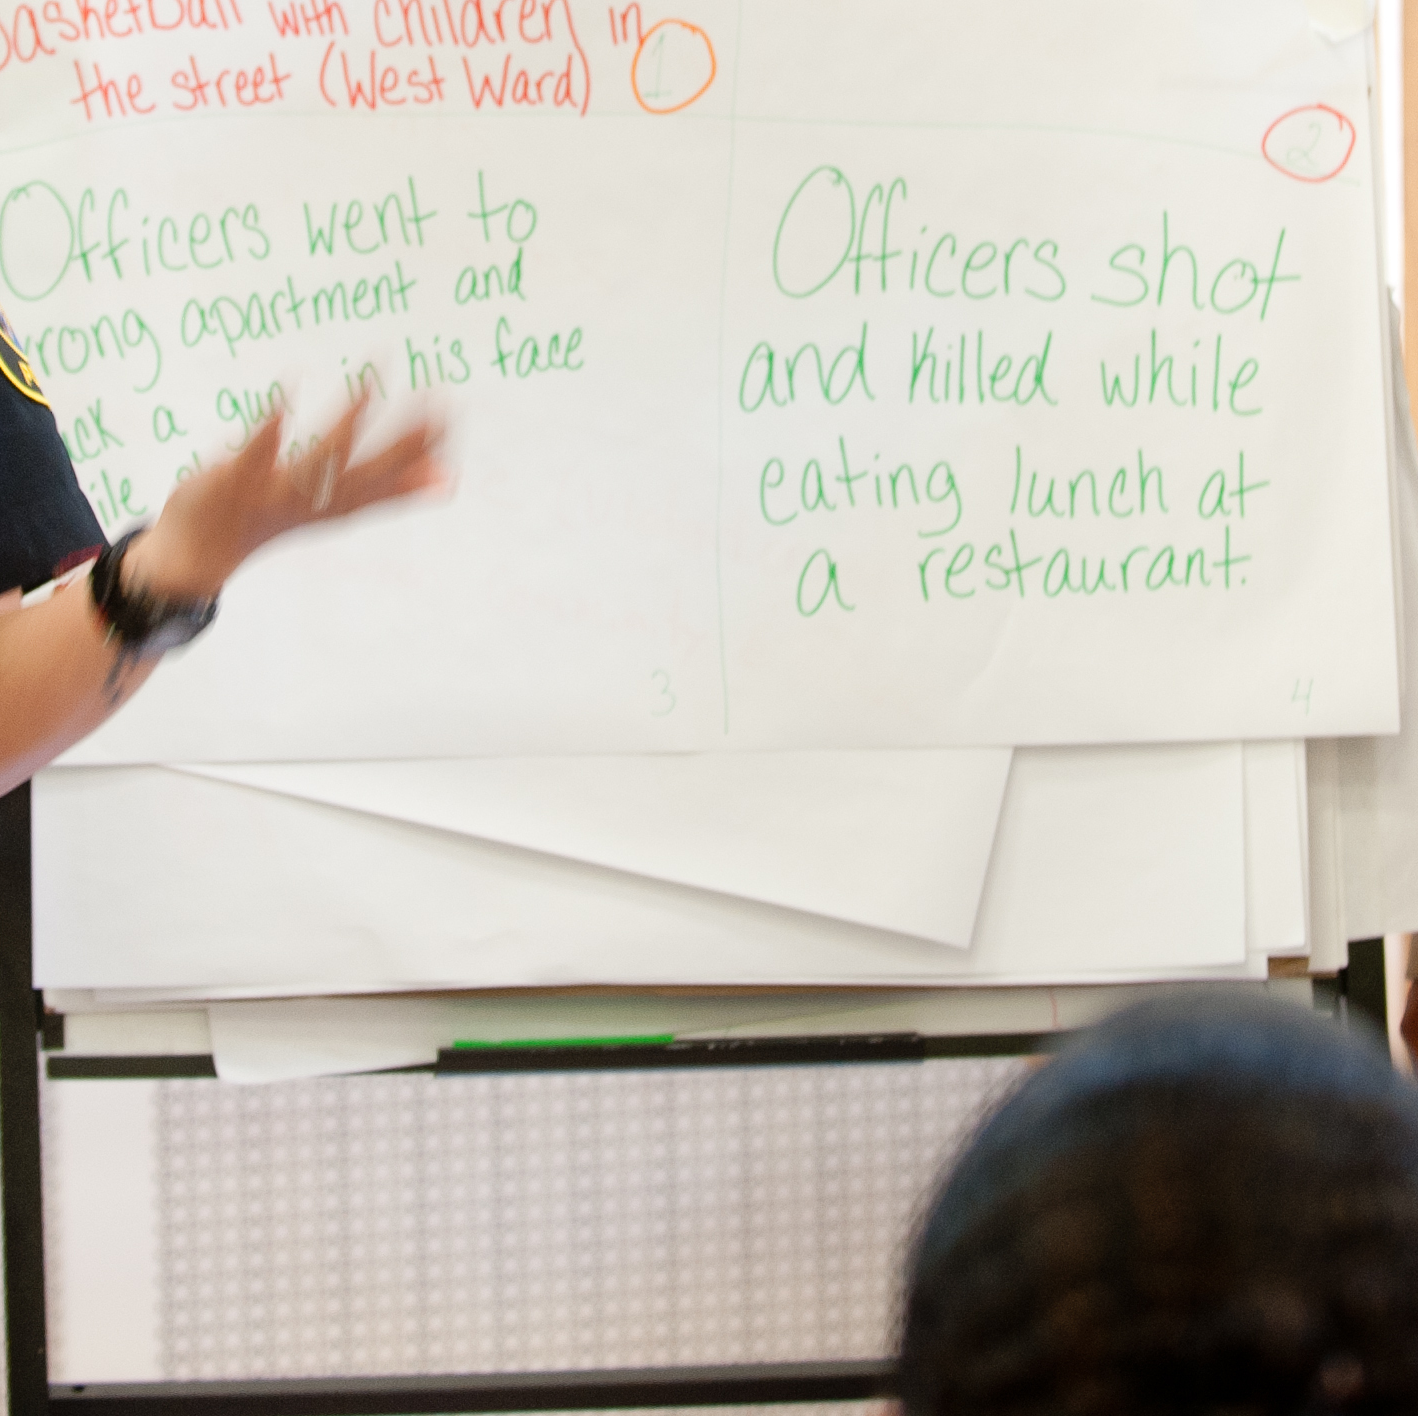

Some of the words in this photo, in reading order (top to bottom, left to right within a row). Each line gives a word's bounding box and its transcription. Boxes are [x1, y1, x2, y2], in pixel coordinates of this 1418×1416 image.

[69, 56, 157, 123] the
[170, 51, 292, 113] street
[318, 41, 448, 114] (West
[461, 45, 593, 118] Ward)
[302, 173, 438, 258] went
[466, 169, 539, 244] to
[772, 164, 1068, 302] Officers
[1090, 209, 1303, 322] shot
[180, 258, 418, 358] apartment
[453, 246, 527, 307] and
[152, 403, 188, 444] a
[405, 333, 472, 392] his
[490, 314, 585, 379] face
[738, 321, 876, 414] and
[1100, 327, 1264, 417] while
[760, 434, 964, 539] eating
[1010, 444, 1169, 519] lunch
[1197, 450, 1272, 521] at
[796, 548, 856, 618] a
[917, 524, 1253, 603] restaurant.
[650, 667, 678, 718] 3
